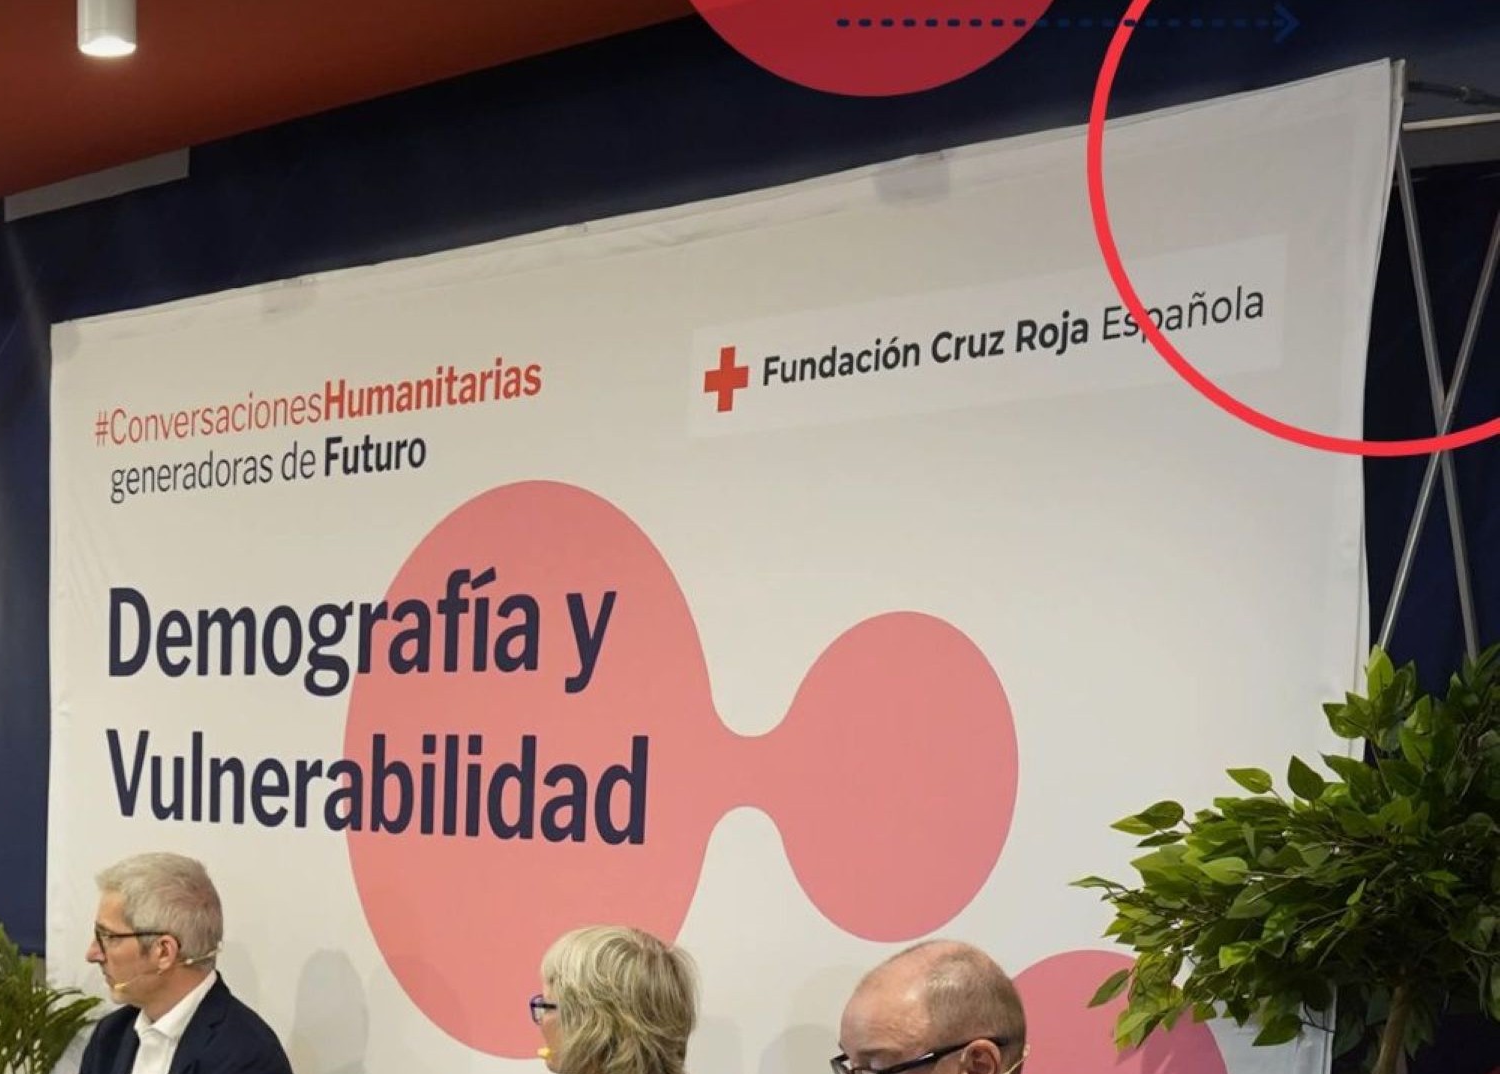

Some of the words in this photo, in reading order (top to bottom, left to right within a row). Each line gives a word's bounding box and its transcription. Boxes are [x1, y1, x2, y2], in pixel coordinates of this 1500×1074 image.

[762, 336, 921, 387] Fundación
[931, 329, 1006, 364] Cruz
[1015, 309, 1090, 356] Roja
[1102, 285, 1264, 344] Española
[95, 356, 543, 447] #ConversacionesHumanitarias
[110, 450, 274, 504] generadoras
[280, 439, 316, 481] de
[323, 434, 427, 477] Futuro
[108, 566, 541, 697] Demografía
[564, 590, 617, 694] y
[106, 728, 649, 845] Vulnerabilidad
